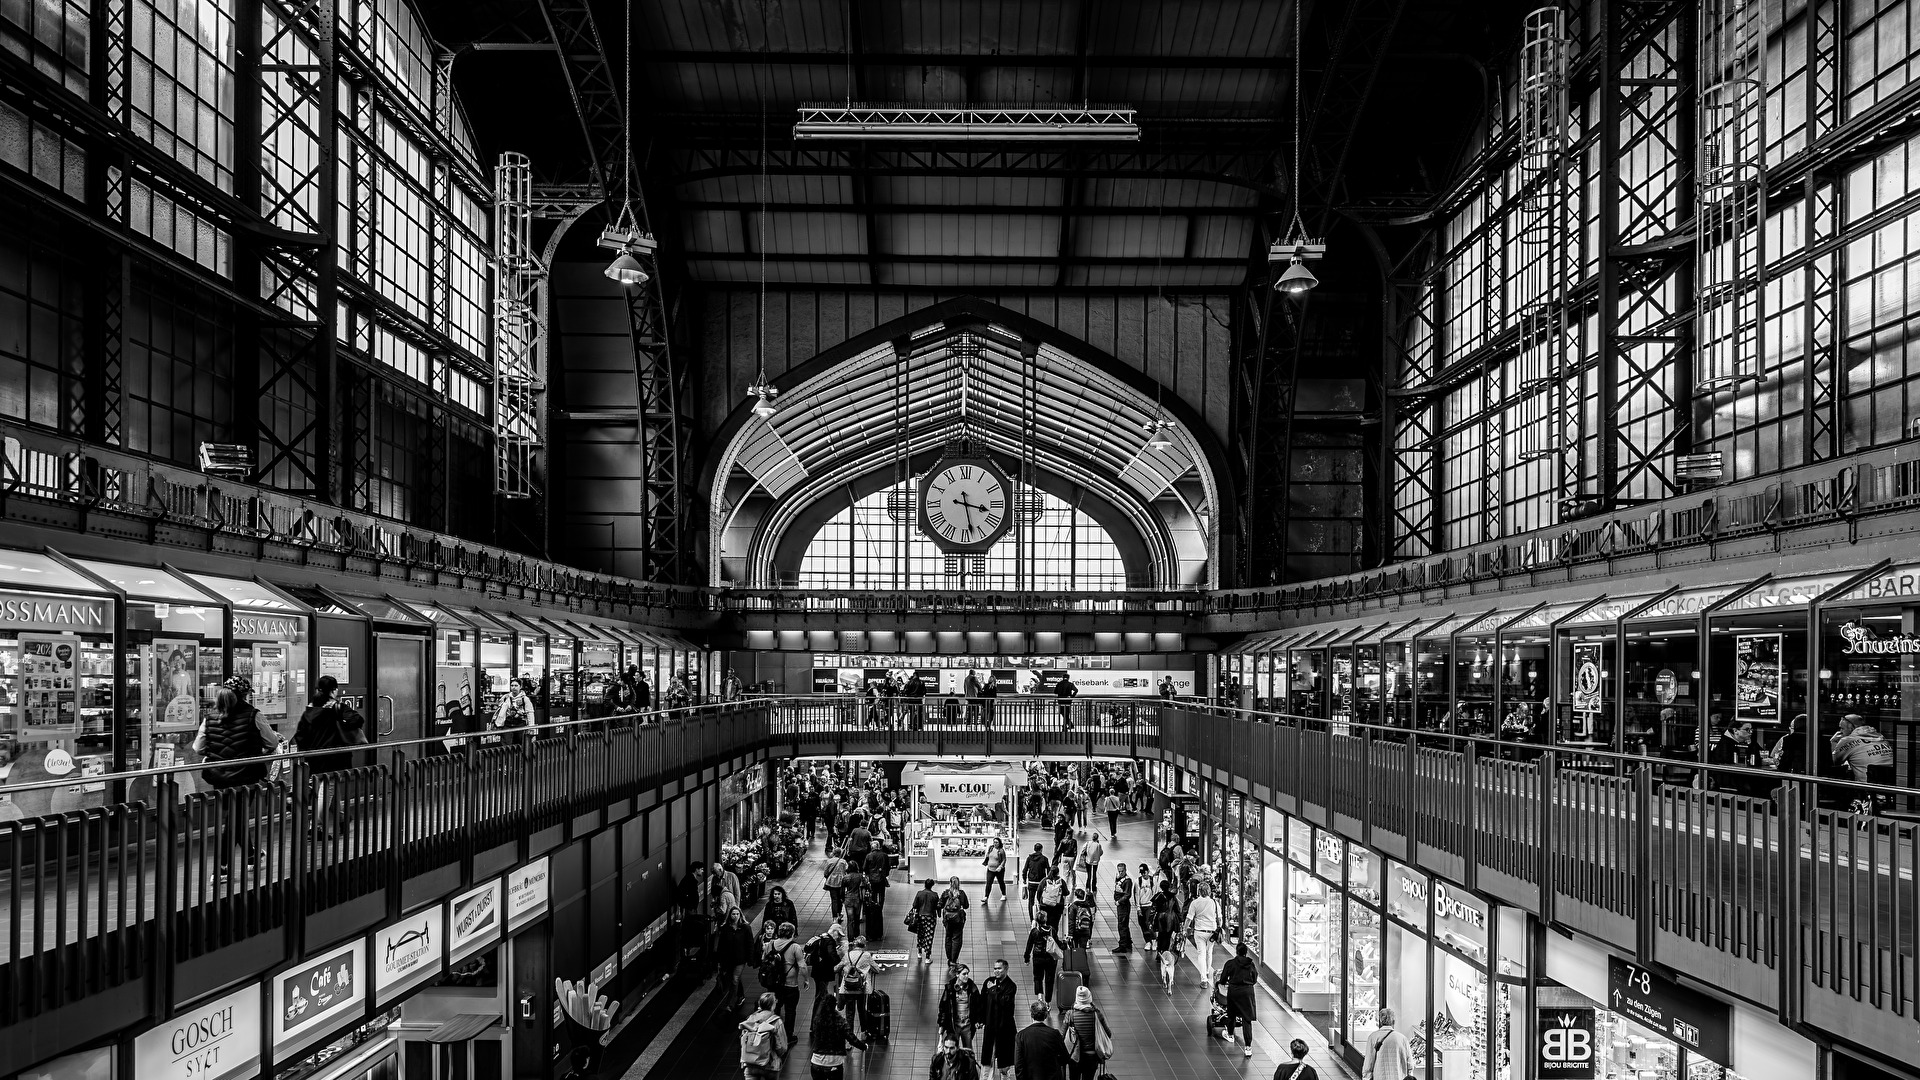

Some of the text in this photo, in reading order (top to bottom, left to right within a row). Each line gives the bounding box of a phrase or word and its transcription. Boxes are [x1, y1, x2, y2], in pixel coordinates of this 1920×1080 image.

[943, 470, 956, 484] XI
[960, 466, 972, 479] XII
[978, 471, 986, 483] I
[932, 484, 945, 494] X
[987, 484, 1000, 494] II
[990, 500, 1004, 508] III
[977, 526, 986, 538] V
[0, 599, 102, 626] SSMANN
[940, 783, 991, 793] Mr. CLOU
[1402, 877, 1425, 900] BIJOU
[456, 909, 475, 938] WURST
[476, 890, 493, 916] DURST
[311, 966, 331, 997] Café
[1449, 974, 1472, 1000] SALE
[1626, 965, 1651, 995] 7-8
[1626, 997, 1662, 1020] zu den Zügen
[171, 1005, 234, 1055] GOSCH
[186, 1046, 220, 1078] SYLT
